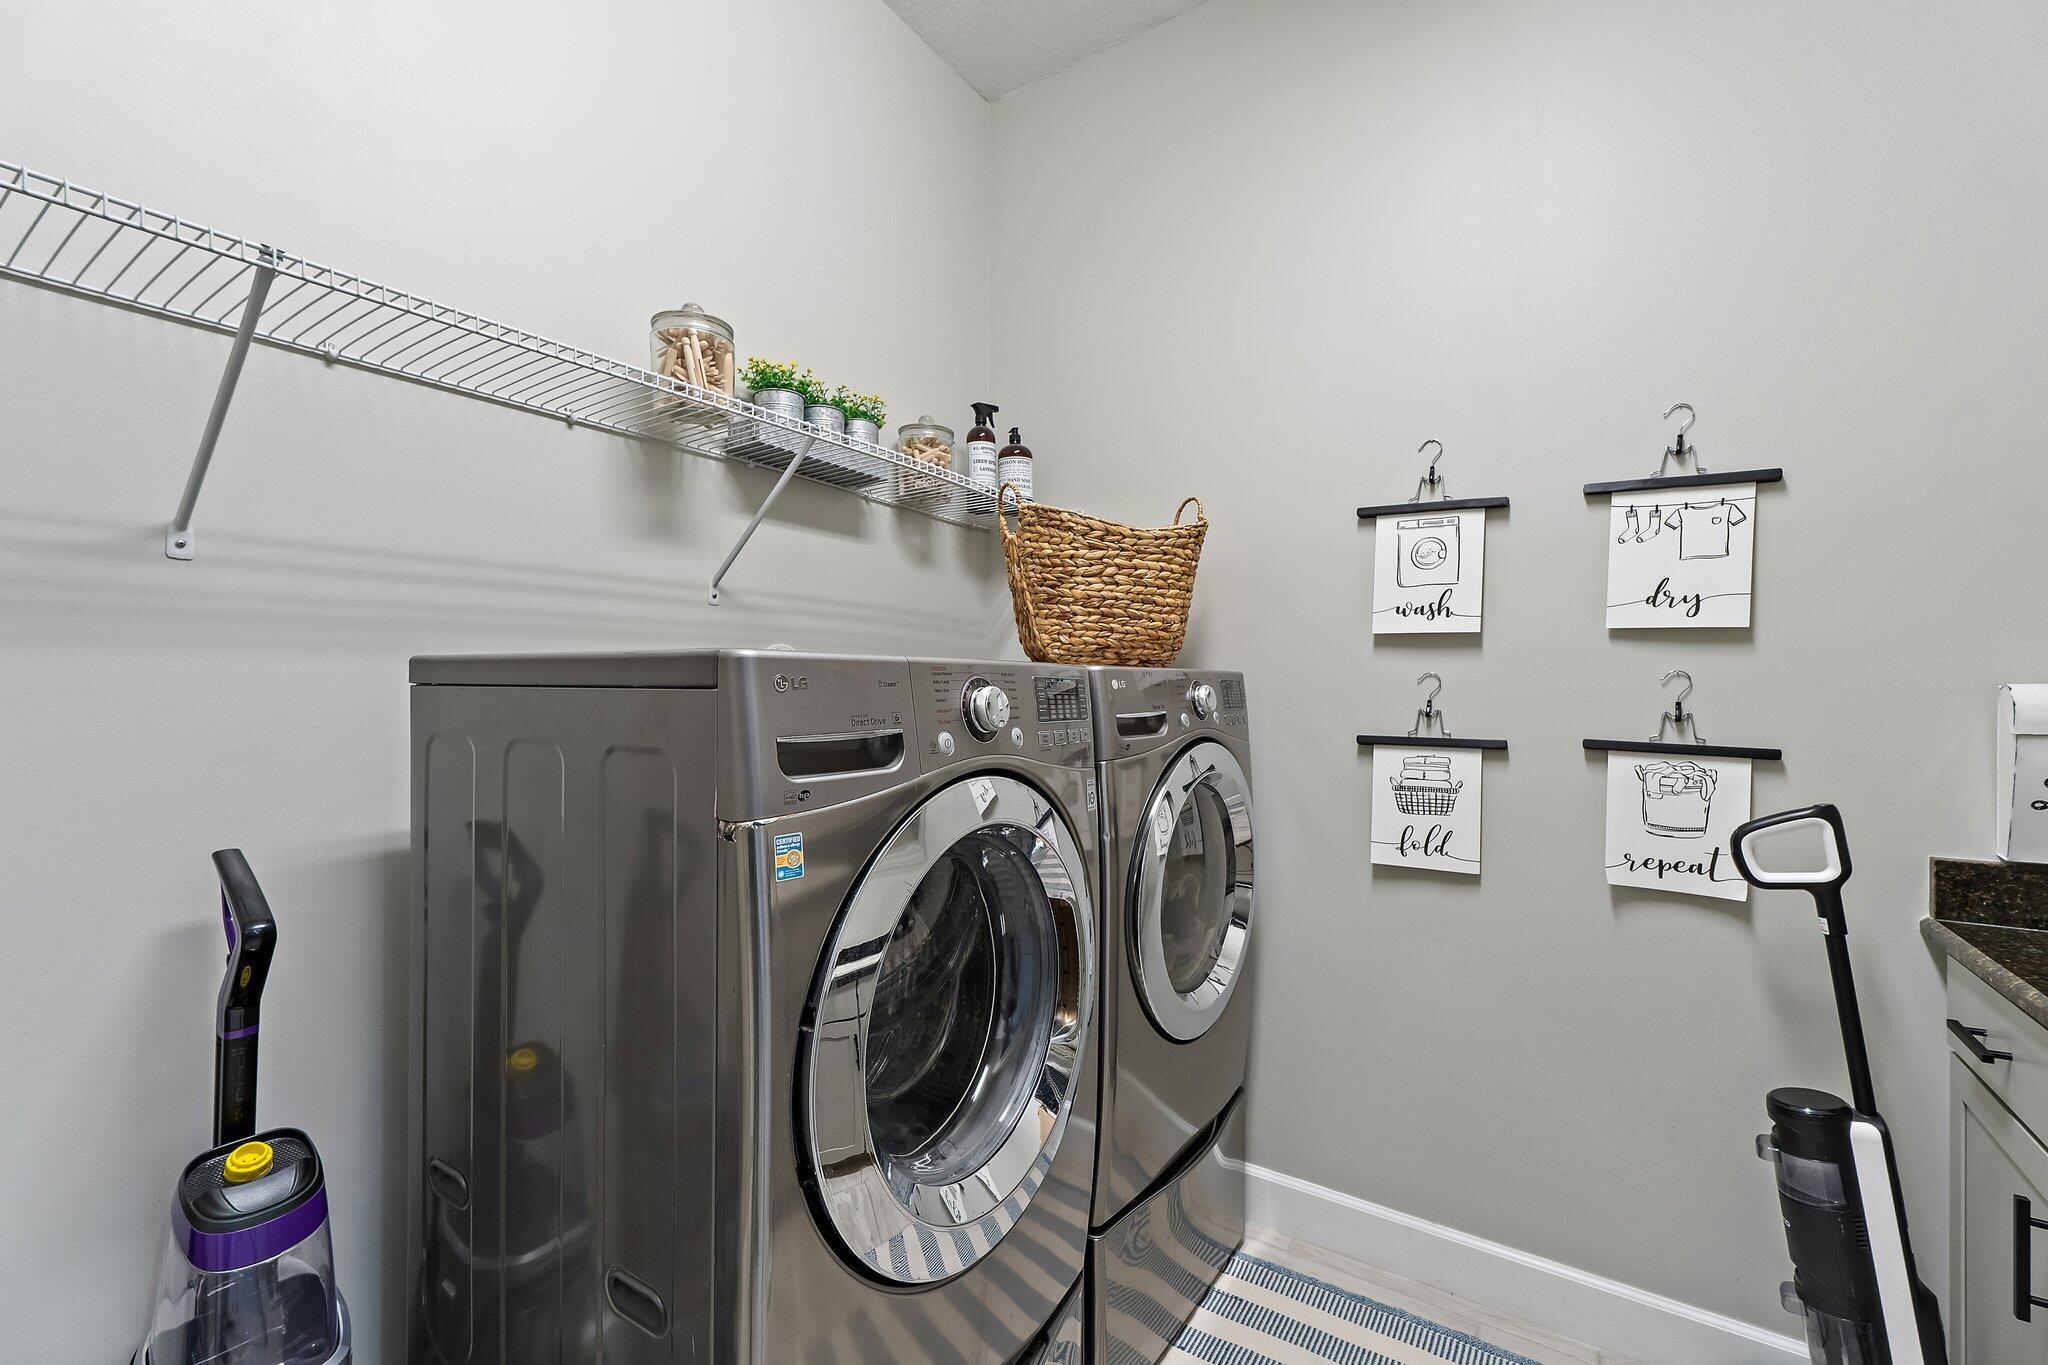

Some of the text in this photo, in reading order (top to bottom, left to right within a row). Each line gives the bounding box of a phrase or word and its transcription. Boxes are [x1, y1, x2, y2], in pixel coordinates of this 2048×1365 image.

[1395, 588, 1456, 621] wash
[1646, 577, 1701, 618] dry
[791, 677, 808, 690] LG
[1118, 680, 1126, 688] LG
[851, 717, 886, 727] Direct Drive
[776, 835, 801, 845] CERTIFIED
[1396, 823, 1454, 858] fold
[1623, 846, 1728, 882] repeat
